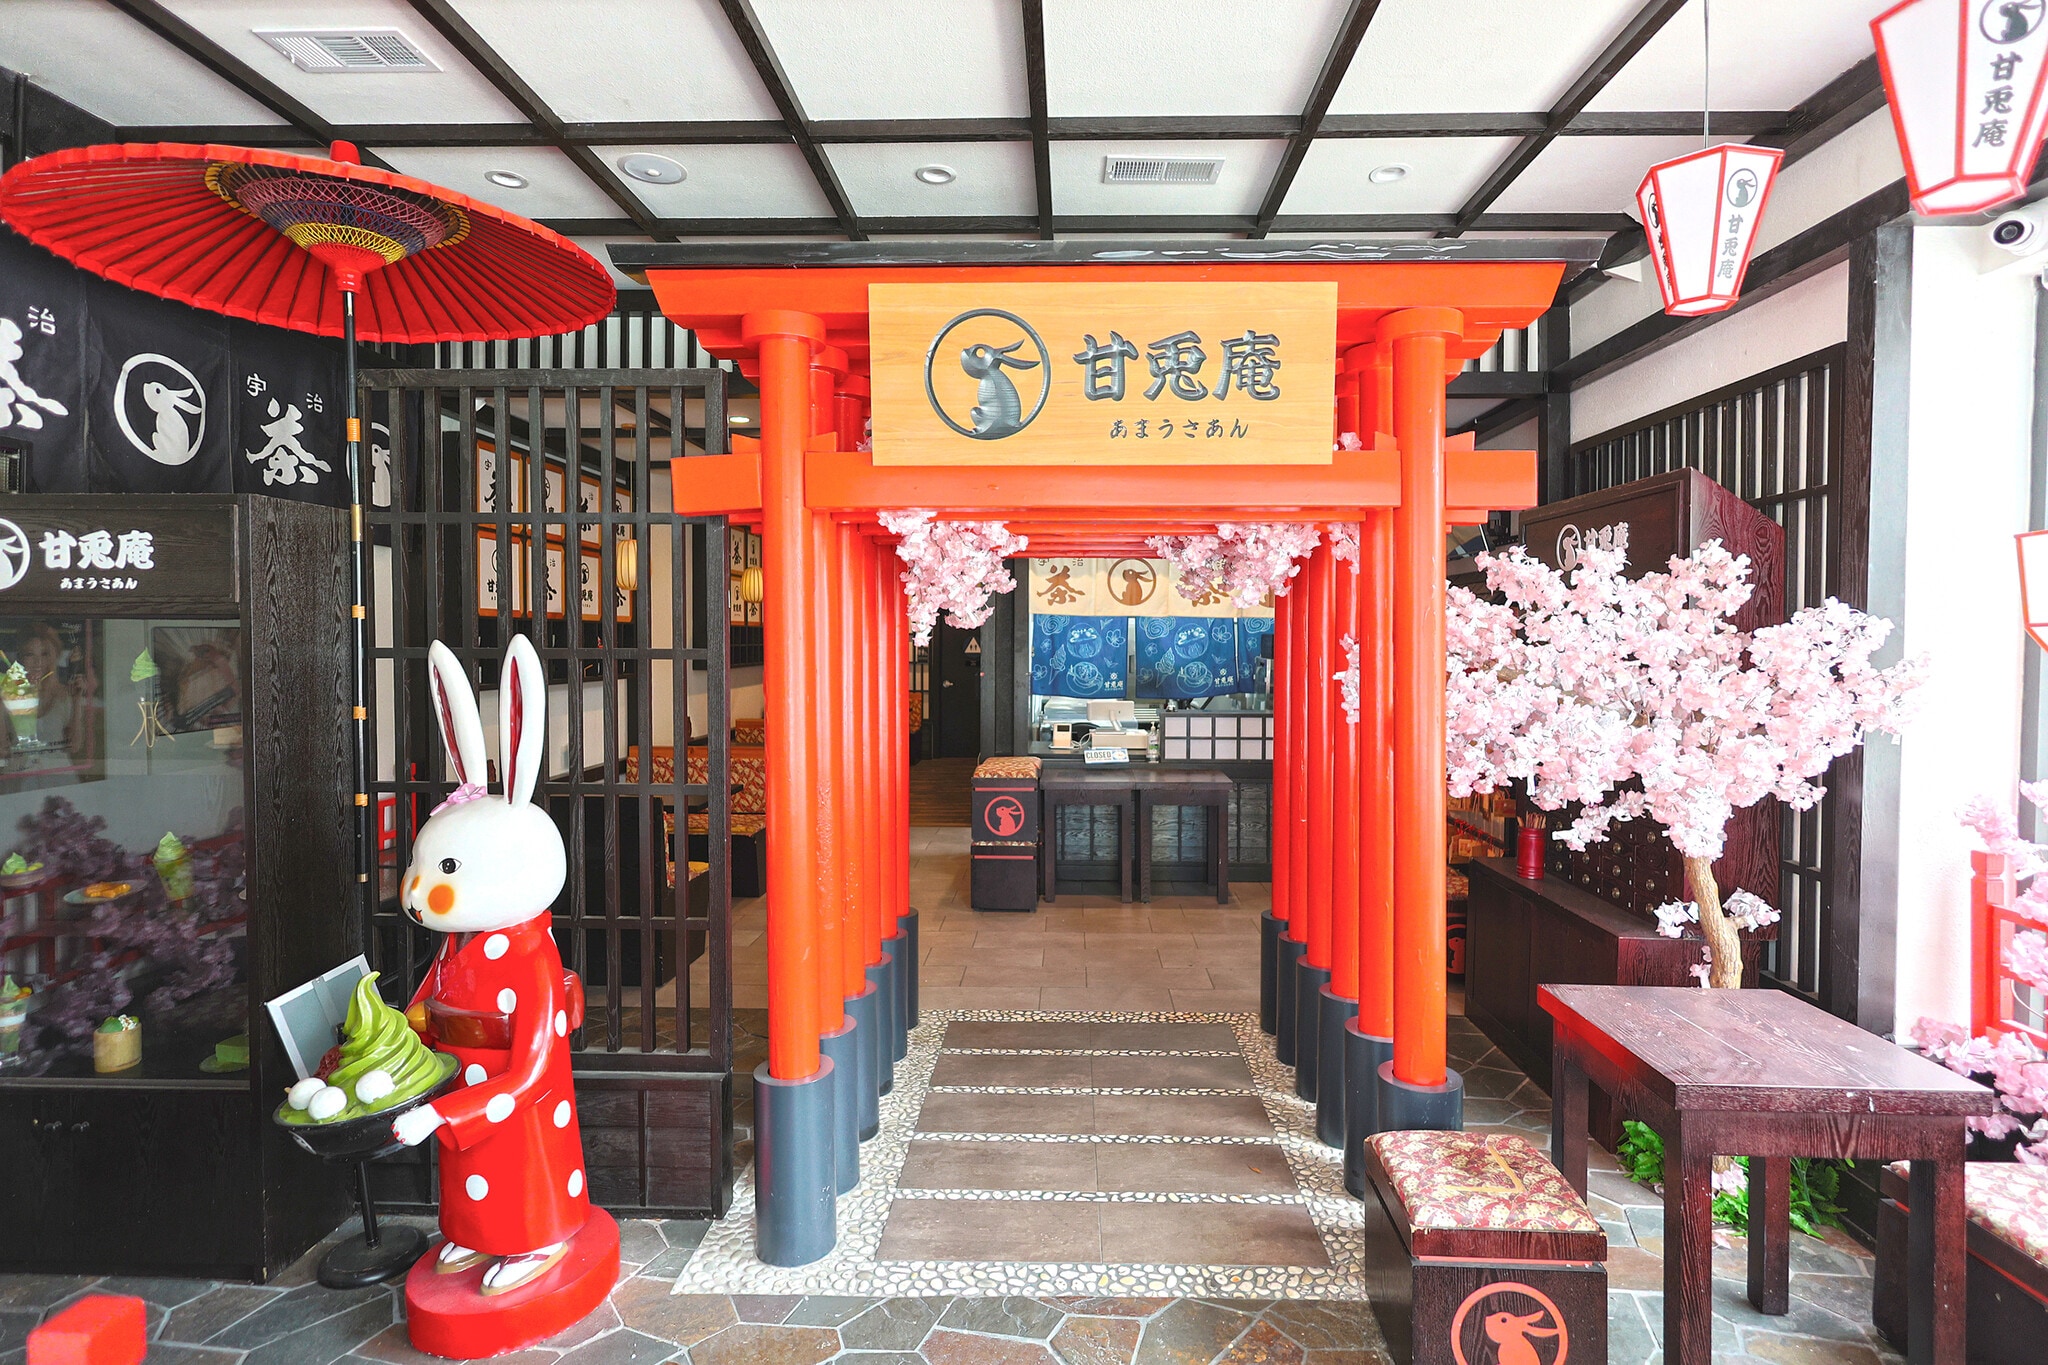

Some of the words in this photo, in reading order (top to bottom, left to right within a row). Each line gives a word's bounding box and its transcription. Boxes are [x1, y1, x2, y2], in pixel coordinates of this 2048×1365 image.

[1972, 51, 2023, 148] 甘兎庵
[1717, 214, 1744, 279] 甘兎庵
[1073, 330, 1282, 401] 甘兎庵
[245, 397, 332, 486] 茶
[1110, 418, 1249, 439] あまうさあん
[38, 530, 155, 569] 甘兎庵
[60, 577, 138, 590] あまうさあん
[1037, 565, 1085, 606] 茶
[1086, 751, 1112, 759] CLOSED
